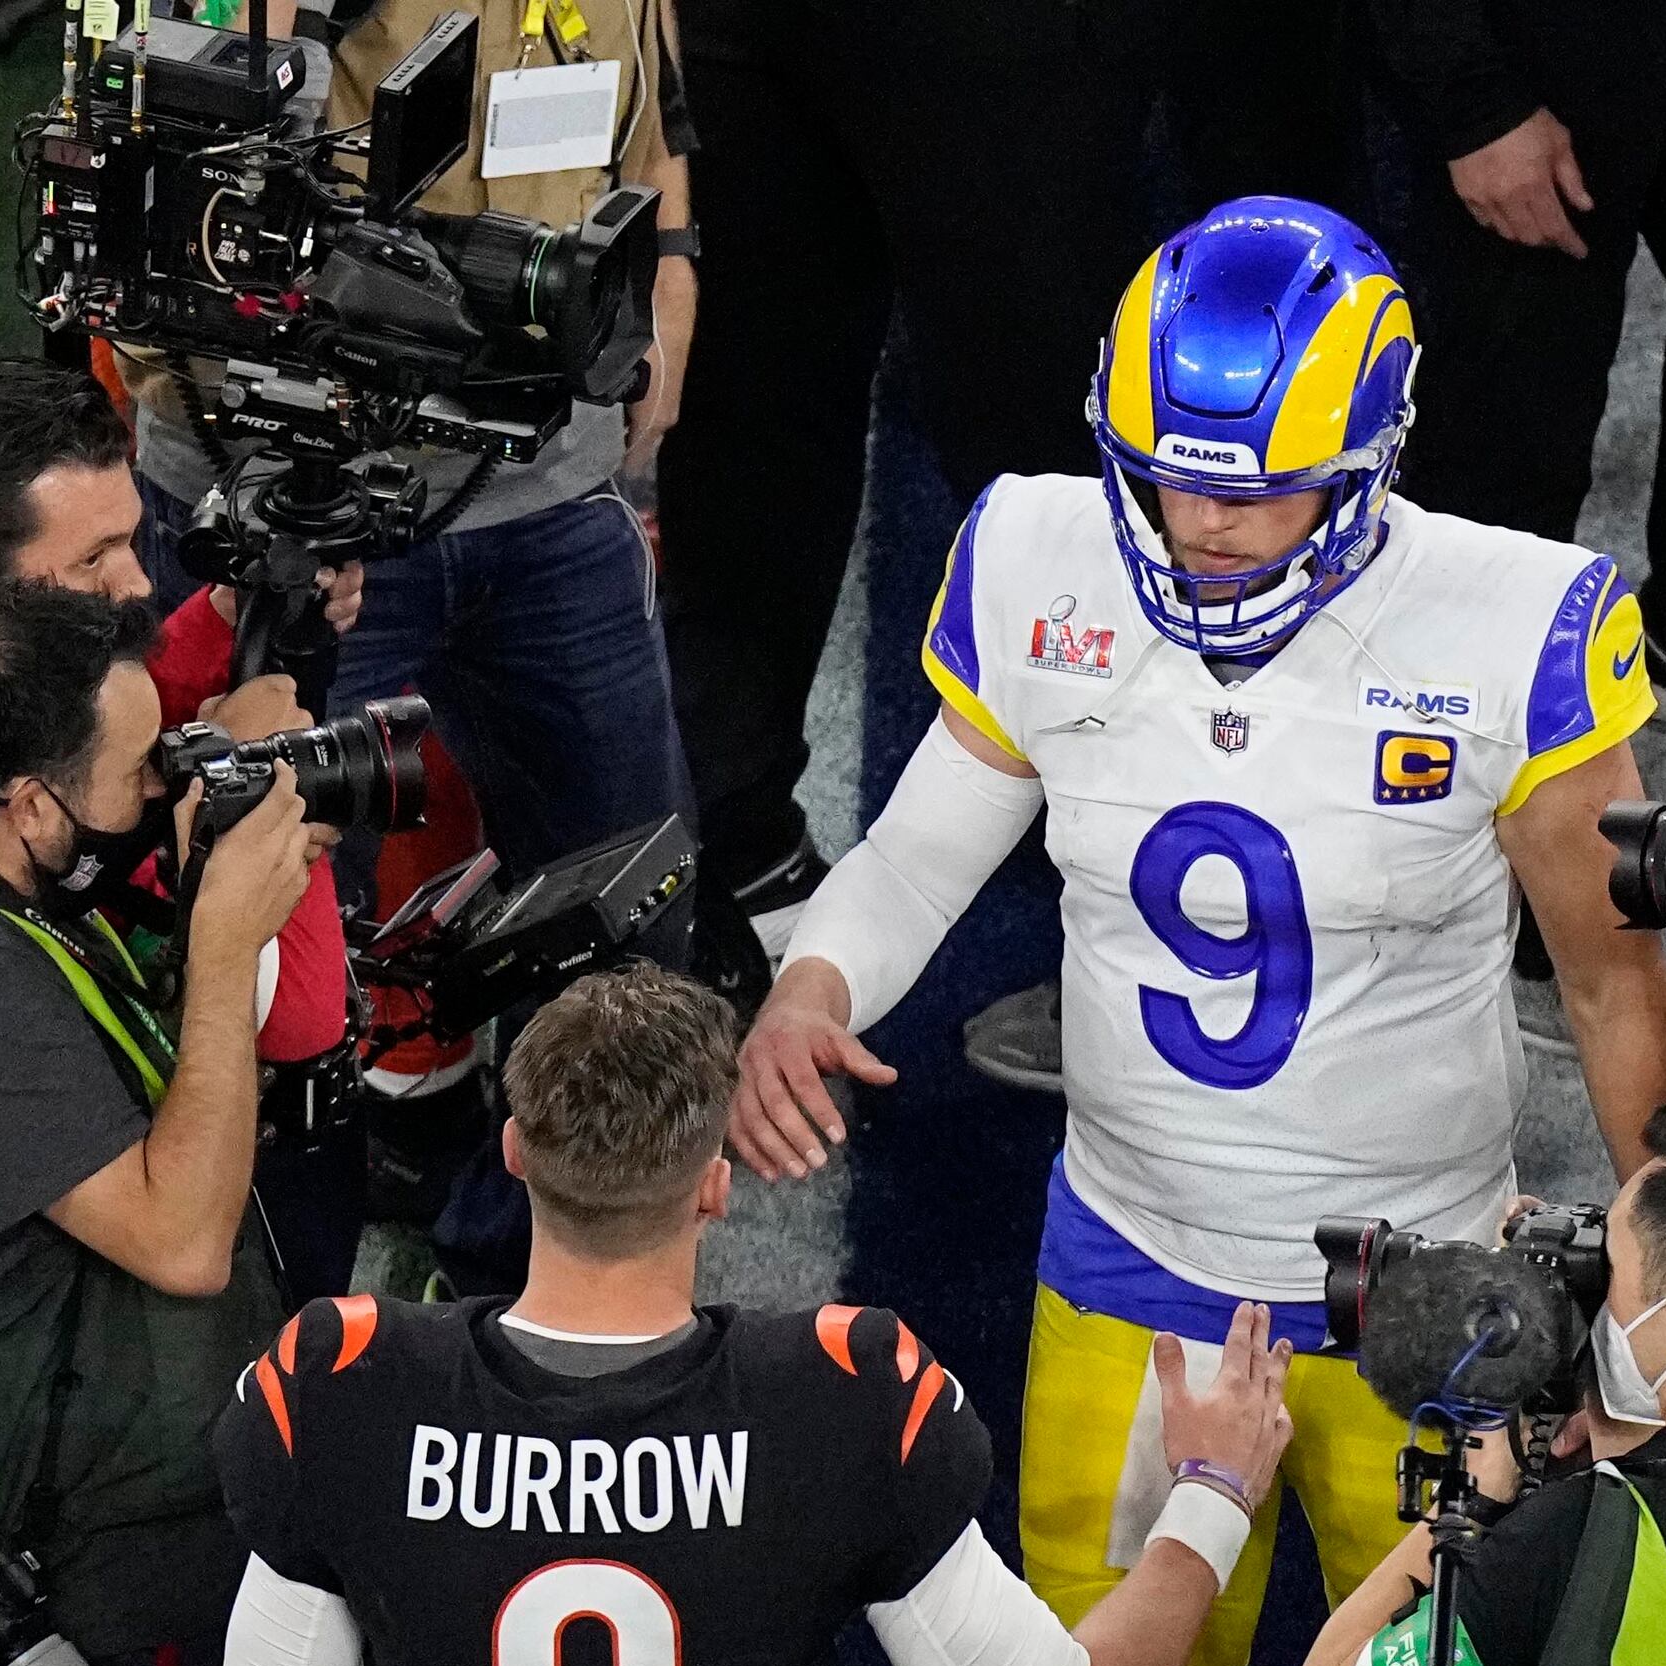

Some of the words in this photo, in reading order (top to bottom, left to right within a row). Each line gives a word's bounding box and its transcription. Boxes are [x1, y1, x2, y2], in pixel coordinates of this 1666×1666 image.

[201, 166, 245, 184] SON
[334, 345, 378, 367] Canon
[232, 412, 284, 431] PRO
[1172, 443, 1237, 465] RAMS
[1033, 658, 1067, 670] SUPER
[1365, 687, 1471, 716] RAMS
[1216, 726, 1243, 748] NFL
[1380, 736, 1452, 789] C
[24, 907, 86, 958] Canon
[1129, 799, 1314, 1091] 9
[406, 1422, 750, 1533] BURROW
